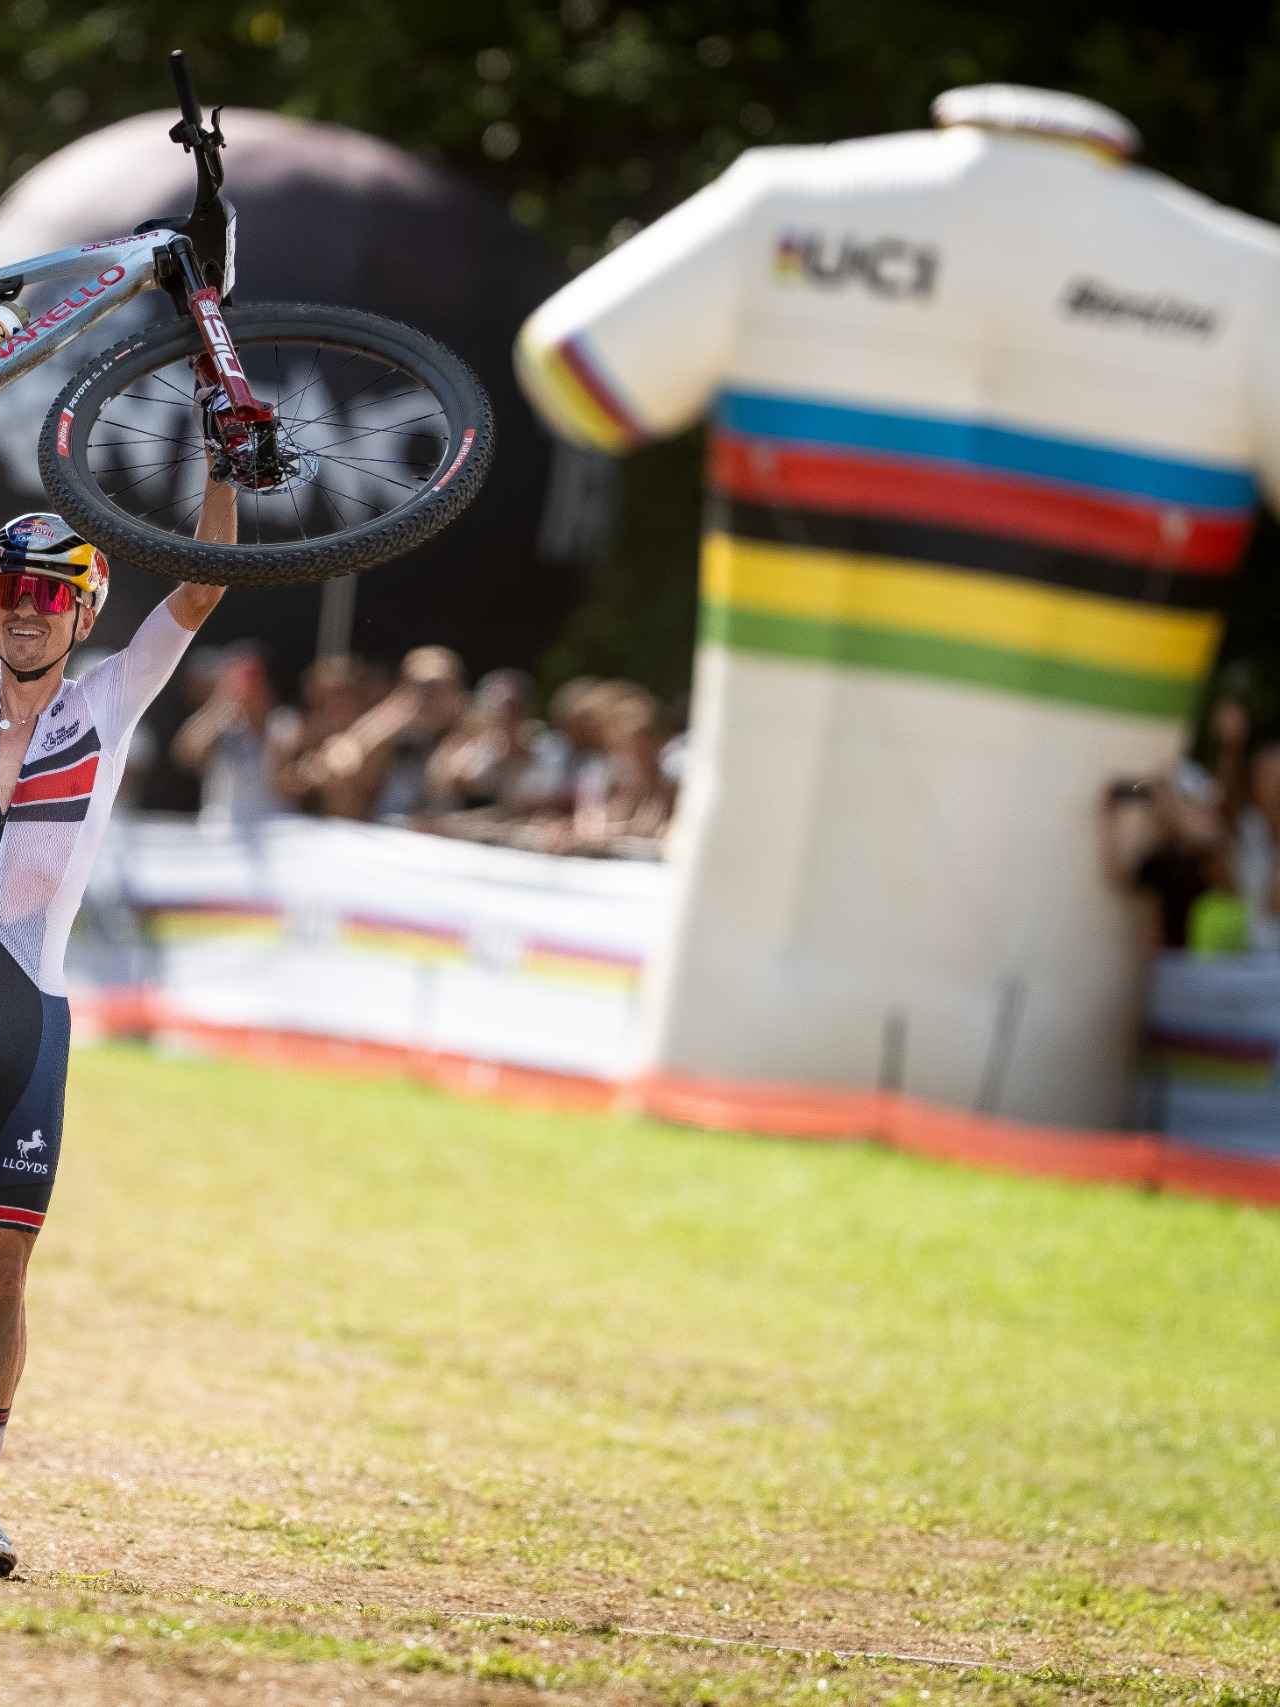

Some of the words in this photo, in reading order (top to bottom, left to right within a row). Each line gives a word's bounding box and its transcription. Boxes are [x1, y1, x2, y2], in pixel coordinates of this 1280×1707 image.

[80, 231, 160, 253] DOGMA
[803, 229, 939, 303] UCI
[68, 378, 92, 409] PEYOTE
[33, 526, 55, 538] Bull
[2, 1157, 49, 1175] LLOYDS
